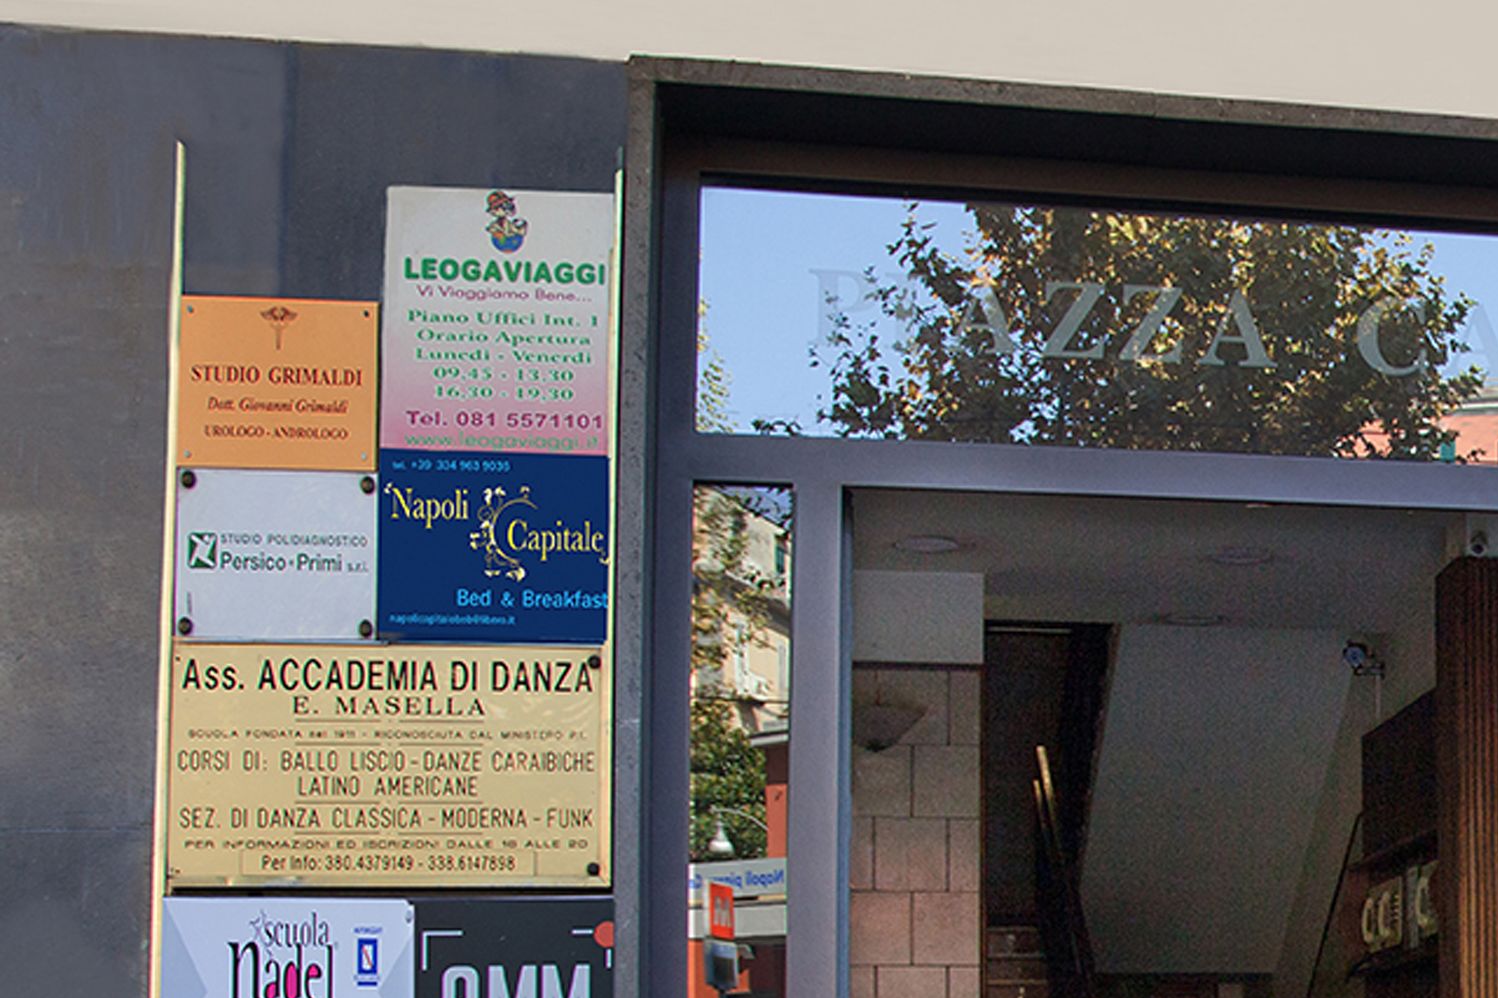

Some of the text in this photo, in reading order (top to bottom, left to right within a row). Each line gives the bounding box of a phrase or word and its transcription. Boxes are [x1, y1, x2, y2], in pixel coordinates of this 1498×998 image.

[404, 257, 605, 285] LEOGAVIAGGI
[417, 286, 433, 297] Vi
[438, 286, 529, 300] Viaggiamo
[408, 310, 469, 324] Piano
[477, 312, 535, 325] Uffici
[544, 313, 580, 327] Int.
[808, 267, 1279, 369] PIAZZA
[417, 329, 590, 347] Orario Apertura
[191, 365, 362, 387] STUDIO GRIMALDI
[433, 367, 492, 381] 09.45
[517, 369, 573, 382] 13.30
[436, 386, 492, 399] 16.30
[517, 387, 573, 401] 19.30
[208, 397, 348, 414] Dott. Giovanni Grimaldi
[406, 411, 602, 429] Tel. 081 5571101
[205, 425, 264, 438] UROLOGO
[274, 427, 348, 440] ANDROLOGO
[405, 431, 599, 451] www.leogaviaggi.it
[388, 486, 469, 528] Napoli
[221, 534, 368, 547] STUDIO POLIDIAGNOSTICO
[507, 519, 606, 561] Capitale
[220, 551, 286, 571] Persico
[296, 553, 342, 572] Primi
[456, 589, 608, 608] Bed & Breakfast
[182, 659, 593, 693] Ass. ACCADEMIA DI DANZA
[292, 697, 486, 716] E. MASELLA
[189, 729, 238, 738] SCUOLA
[245, 729, 302, 738] FONDATA
[375, 729, 463, 739] RICONOSCIUTA
[469, 730, 493, 739] DAL
[177, 750, 230, 771] CORSI
[280, 750, 338, 772] BALLO
[350, 750, 406, 772] LISCIO
[423, 751, 482, 772] DANZE
[492, 751, 594, 773] CARAIBICHE
[297, 775, 478, 797] LATINO AMERICANE
[179, 807, 221, 829] SEZ.
[230, 807, 249, 829] DI
[256, 807, 320, 829] DANZA
[332, 807, 422, 829] CLASSICA
[441, 808, 527, 829] MODERNA
[547, 808, 593, 829] FUNK
[184, 840, 214, 849] PER
[223, 840, 330, 849] INFORMAZIONI
[336, 840, 356, 849] ED
[363, 840, 440, 849] ISCRIZIONI
[446, 840, 493, 849] DALLE
[524, 840, 561, 849] ALLE
[262, 854, 286, 871] Per
[263, 911, 330, 948] scuola
